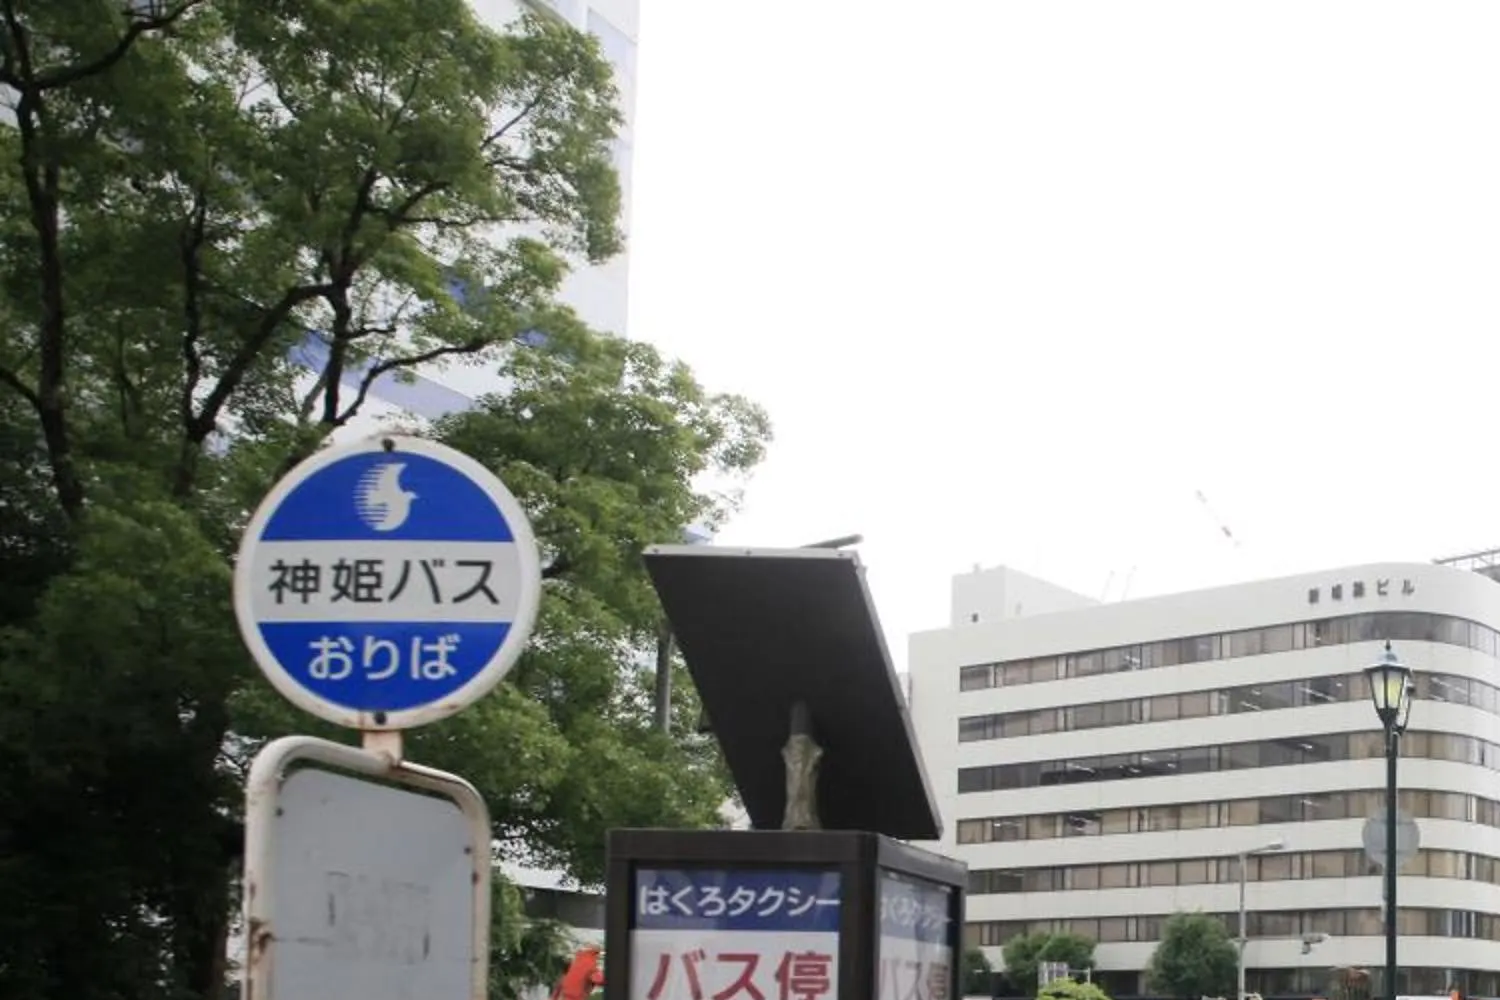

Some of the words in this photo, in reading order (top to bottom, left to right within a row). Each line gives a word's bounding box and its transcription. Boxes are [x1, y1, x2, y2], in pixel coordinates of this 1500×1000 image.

[268, 558, 500, 605] 神姫バス
[308, 633, 463, 681] おりば
[639, 884, 841, 916] はくろタクシー
